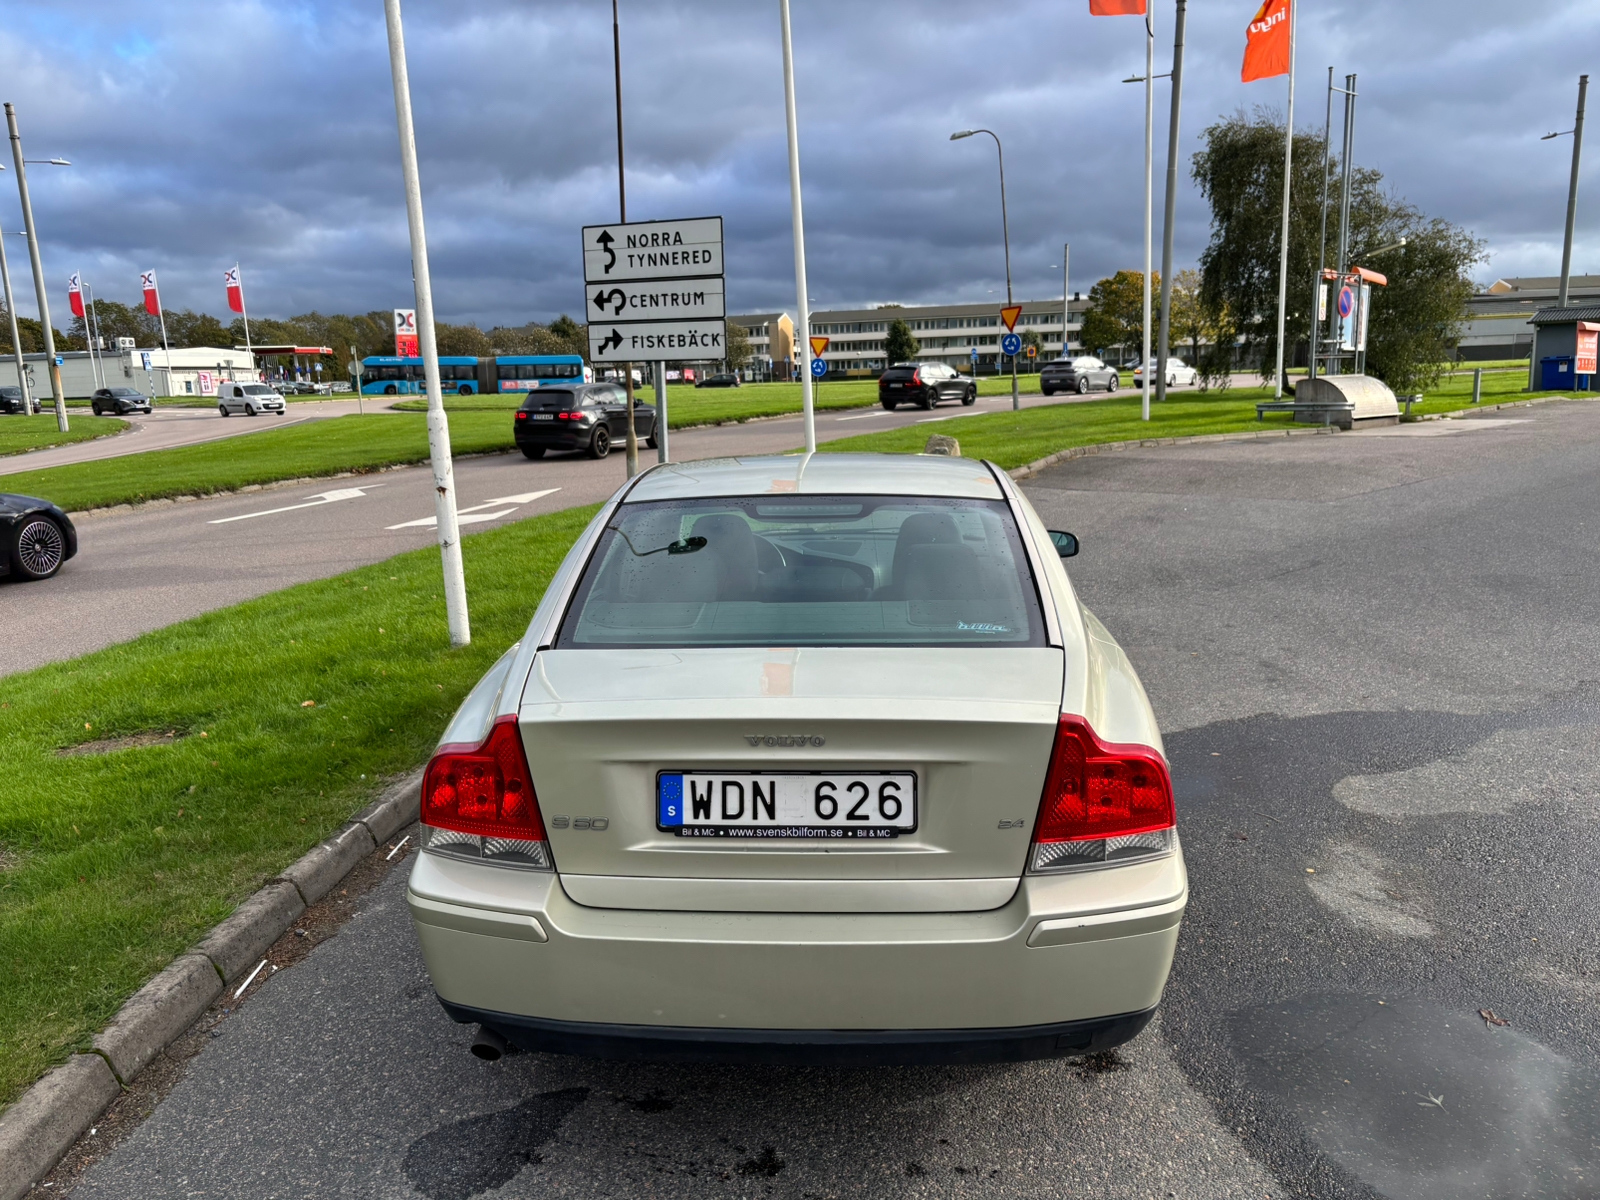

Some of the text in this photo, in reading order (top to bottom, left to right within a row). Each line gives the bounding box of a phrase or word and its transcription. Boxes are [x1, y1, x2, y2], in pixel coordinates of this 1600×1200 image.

[626, 231, 684, 249] NORRA
[627, 249, 713, 268] TYNNERED
[629, 291, 705, 308] CENTRUM
[631, 329, 721, 349] FISKEBÄCK
[744, 734, 826, 747] VOLVO
[690, 780, 902, 821] WDN 626
[667, 805, 676, 817] S
[551, 814, 610, 831] S60
[682, 826, 891, 839] Bil & MC www.svenskbilform.se Bil & MC
